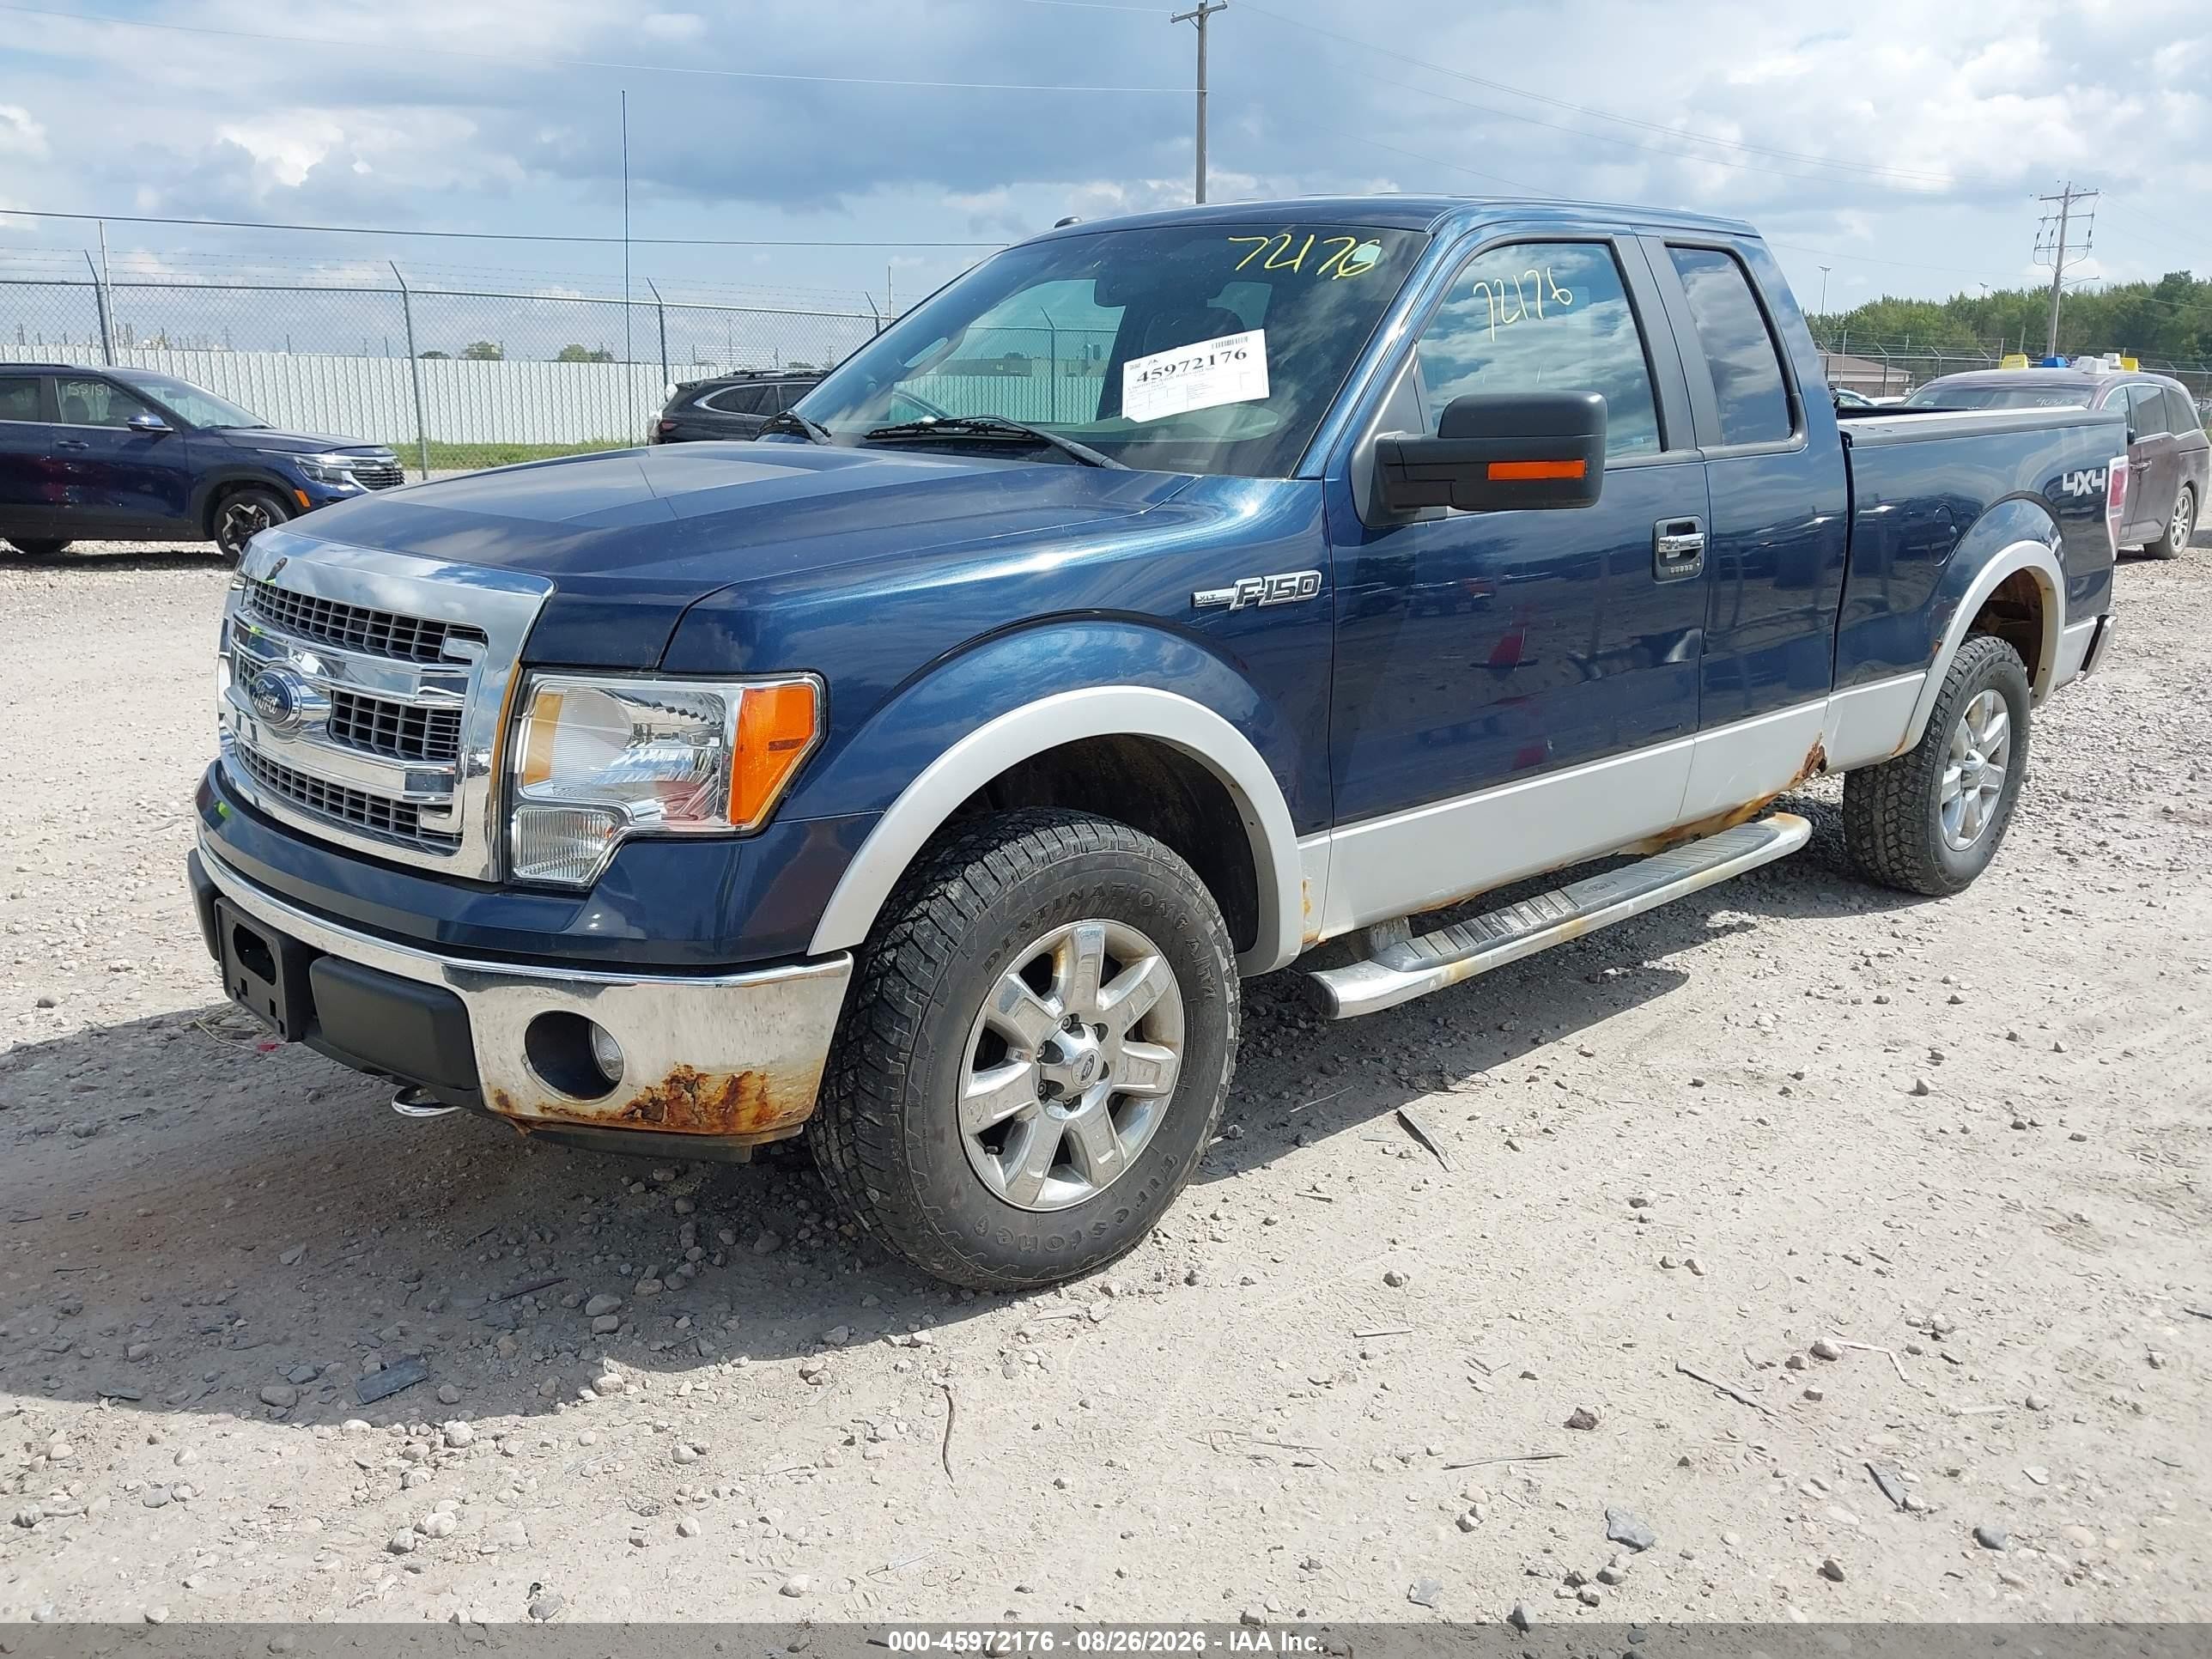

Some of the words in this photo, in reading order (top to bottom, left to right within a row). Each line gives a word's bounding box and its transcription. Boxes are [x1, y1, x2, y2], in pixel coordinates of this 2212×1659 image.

[1228, 233, 1381, 281] 72176
[1473, 266, 1573, 343] 72176
[1136, 347, 1248, 383] 45972176
[1231, 570, 1322, 610] F-150
[252, 678, 281, 714] Ford
